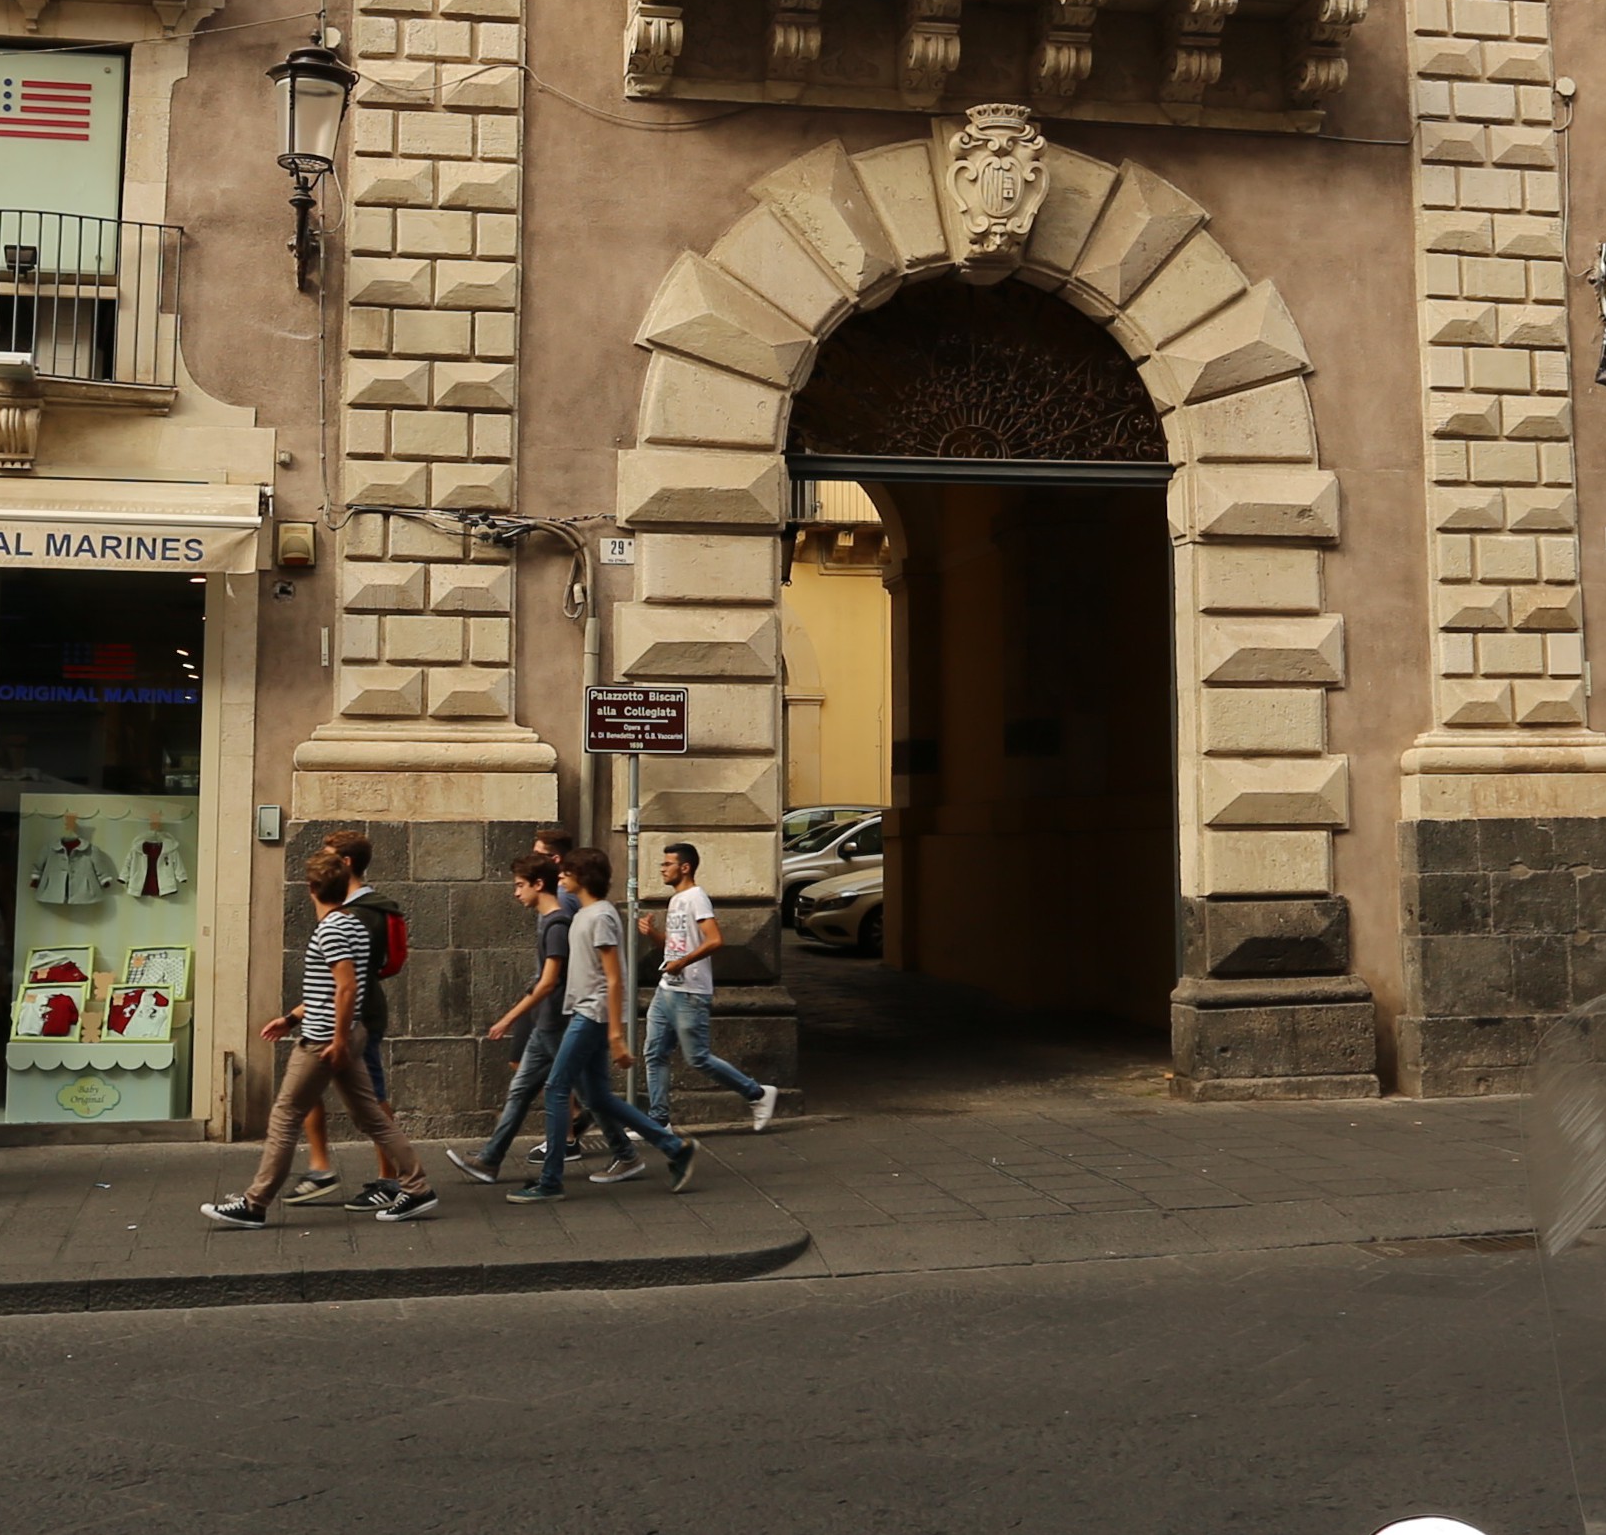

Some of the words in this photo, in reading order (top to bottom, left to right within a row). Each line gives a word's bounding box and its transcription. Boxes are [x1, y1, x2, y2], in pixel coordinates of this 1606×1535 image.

[44, 533, 205, 563] MARINES
[611, 540, 624, 555] 29
[103, 687, 198, 704] MARINES
[590, 691, 644, 701] Palazzotto
[648, 692, 684, 702] Biscari
[597, 706, 617, 715] alla
[623, 706, 677, 718] Collegiata
